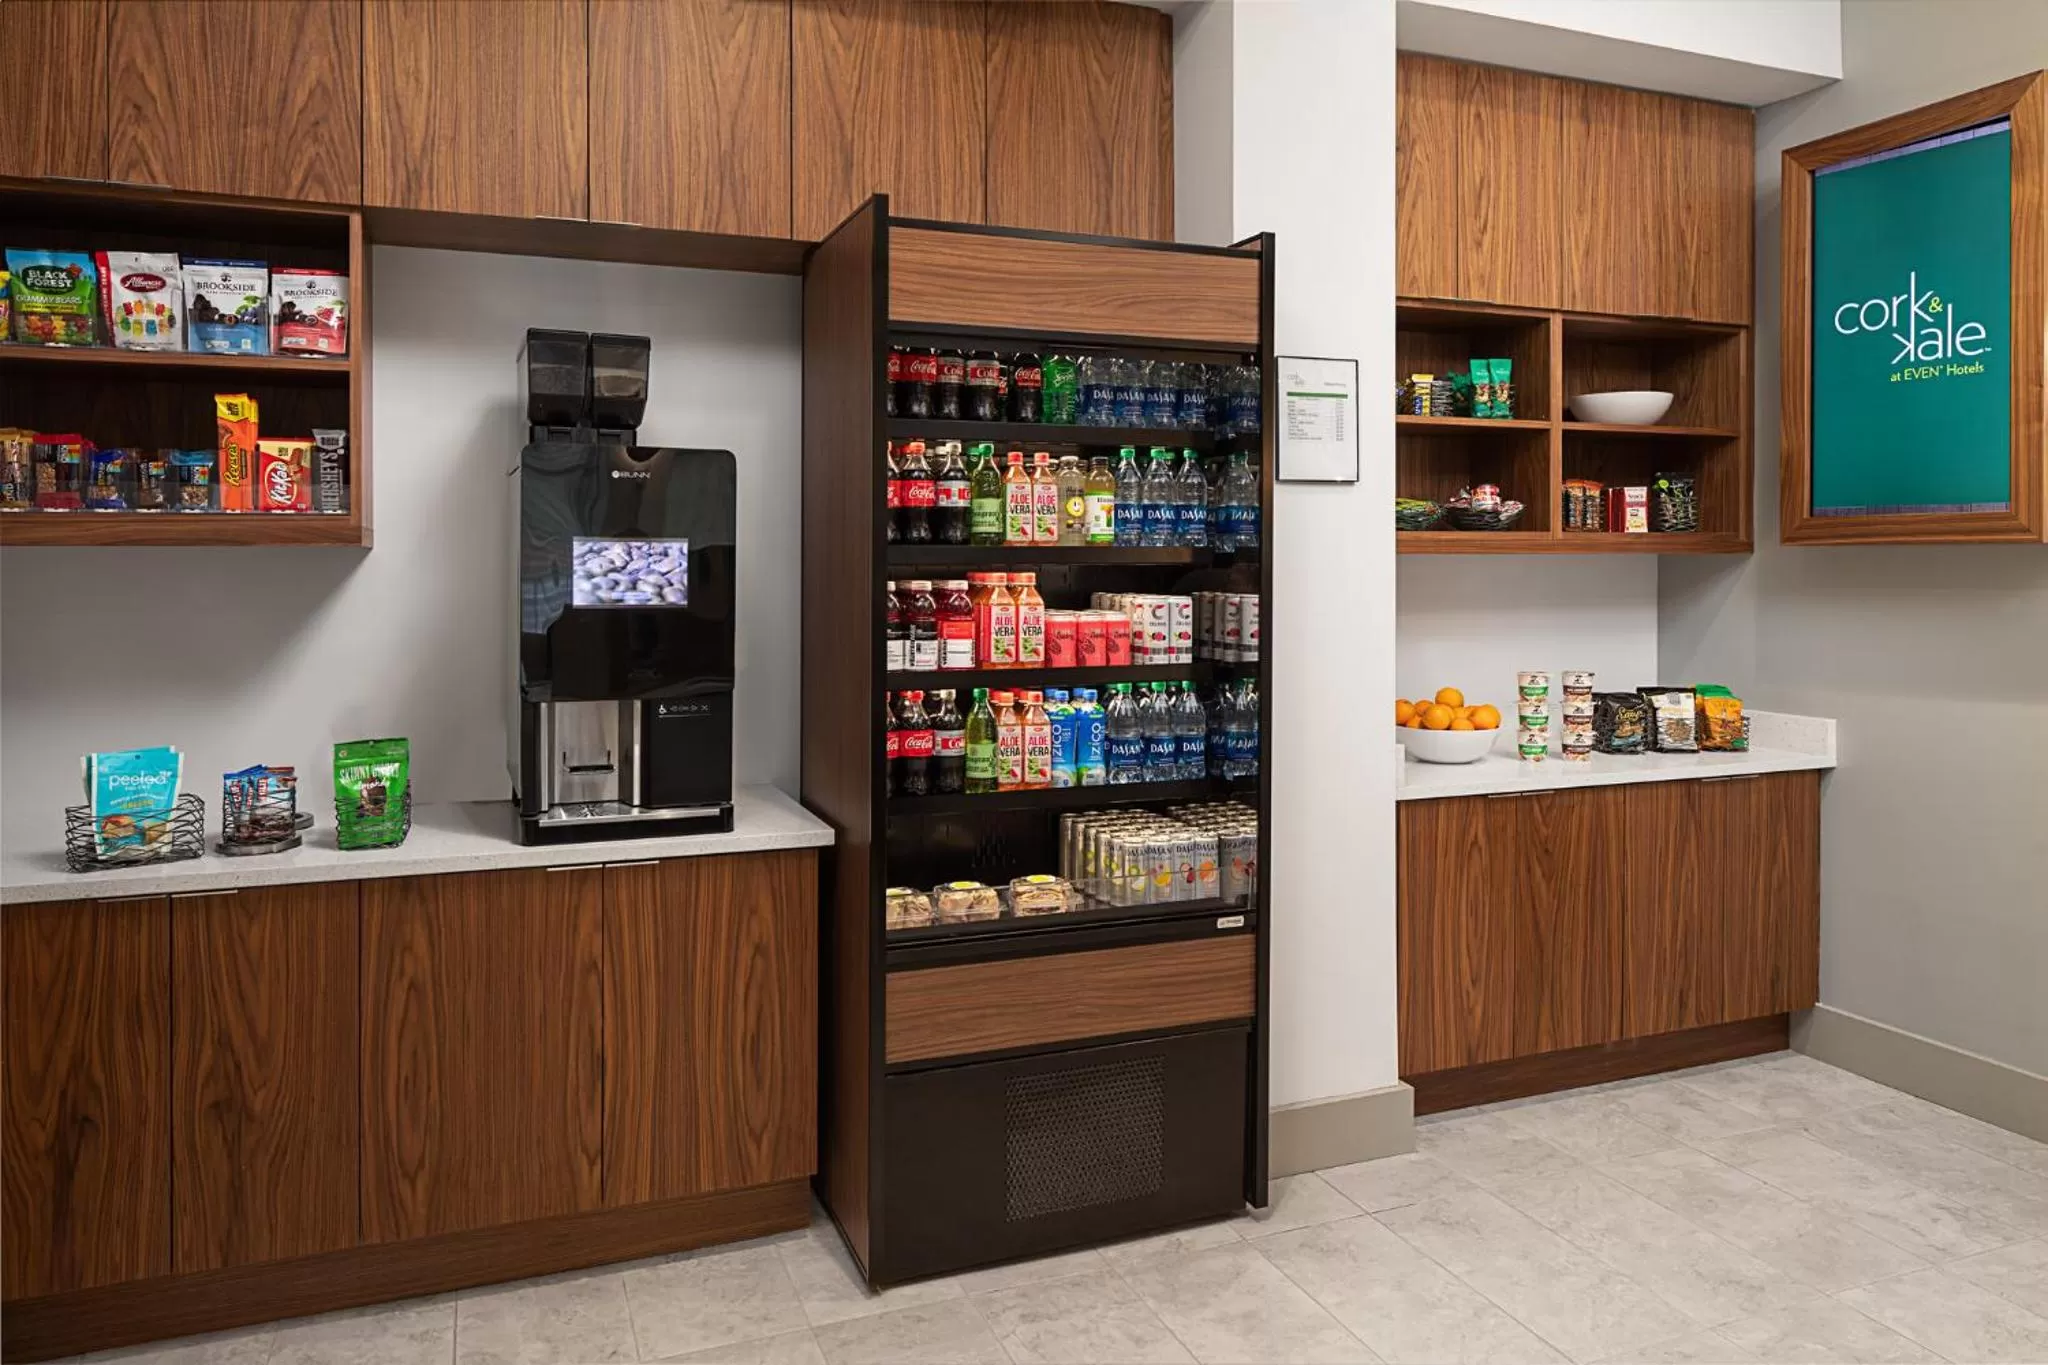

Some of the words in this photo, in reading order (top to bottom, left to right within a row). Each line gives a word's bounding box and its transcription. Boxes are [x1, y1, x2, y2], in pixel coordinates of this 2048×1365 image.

[28, 269, 68, 279] BLACK
[26, 278, 73, 288] FOREST
[196, 281, 256, 292] BROOKSIDE
[284, 288, 338, 298] BROOKSIDE
[1834, 271, 1934, 335] cork
[1928, 297, 1943, 313] &
[1891, 303, 1986, 365] kale
[1890, 372, 1901, 382] at
[1946, 361, 1985, 378] Hotels
[223, 443, 241, 487] Reese's
[1010, 494, 1030, 504] ALOE
[1037, 494, 1056, 505] ALOE
[1010, 505, 1030, 514] VERA
[1036, 505, 1056, 515] VERA
[995, 616, 1013, 626] ALOE
[1023, 616, 1041, 626] ALOE
[994, 626, 1015, 637] VERA
[1022, 626, 1042, 637] VERA
[1001, 736, 1020, 747] ALOE
[1028, 736, 1049, 746] ALOE
[1053, 724, 1062, 757] ZICO
[1092, 723, 1101, 757] ZICO
[1000, 747, 1020, 757] VERA
[1028, 746, 1050, 757] VERA
[109, 770, 167, 791] peeled
